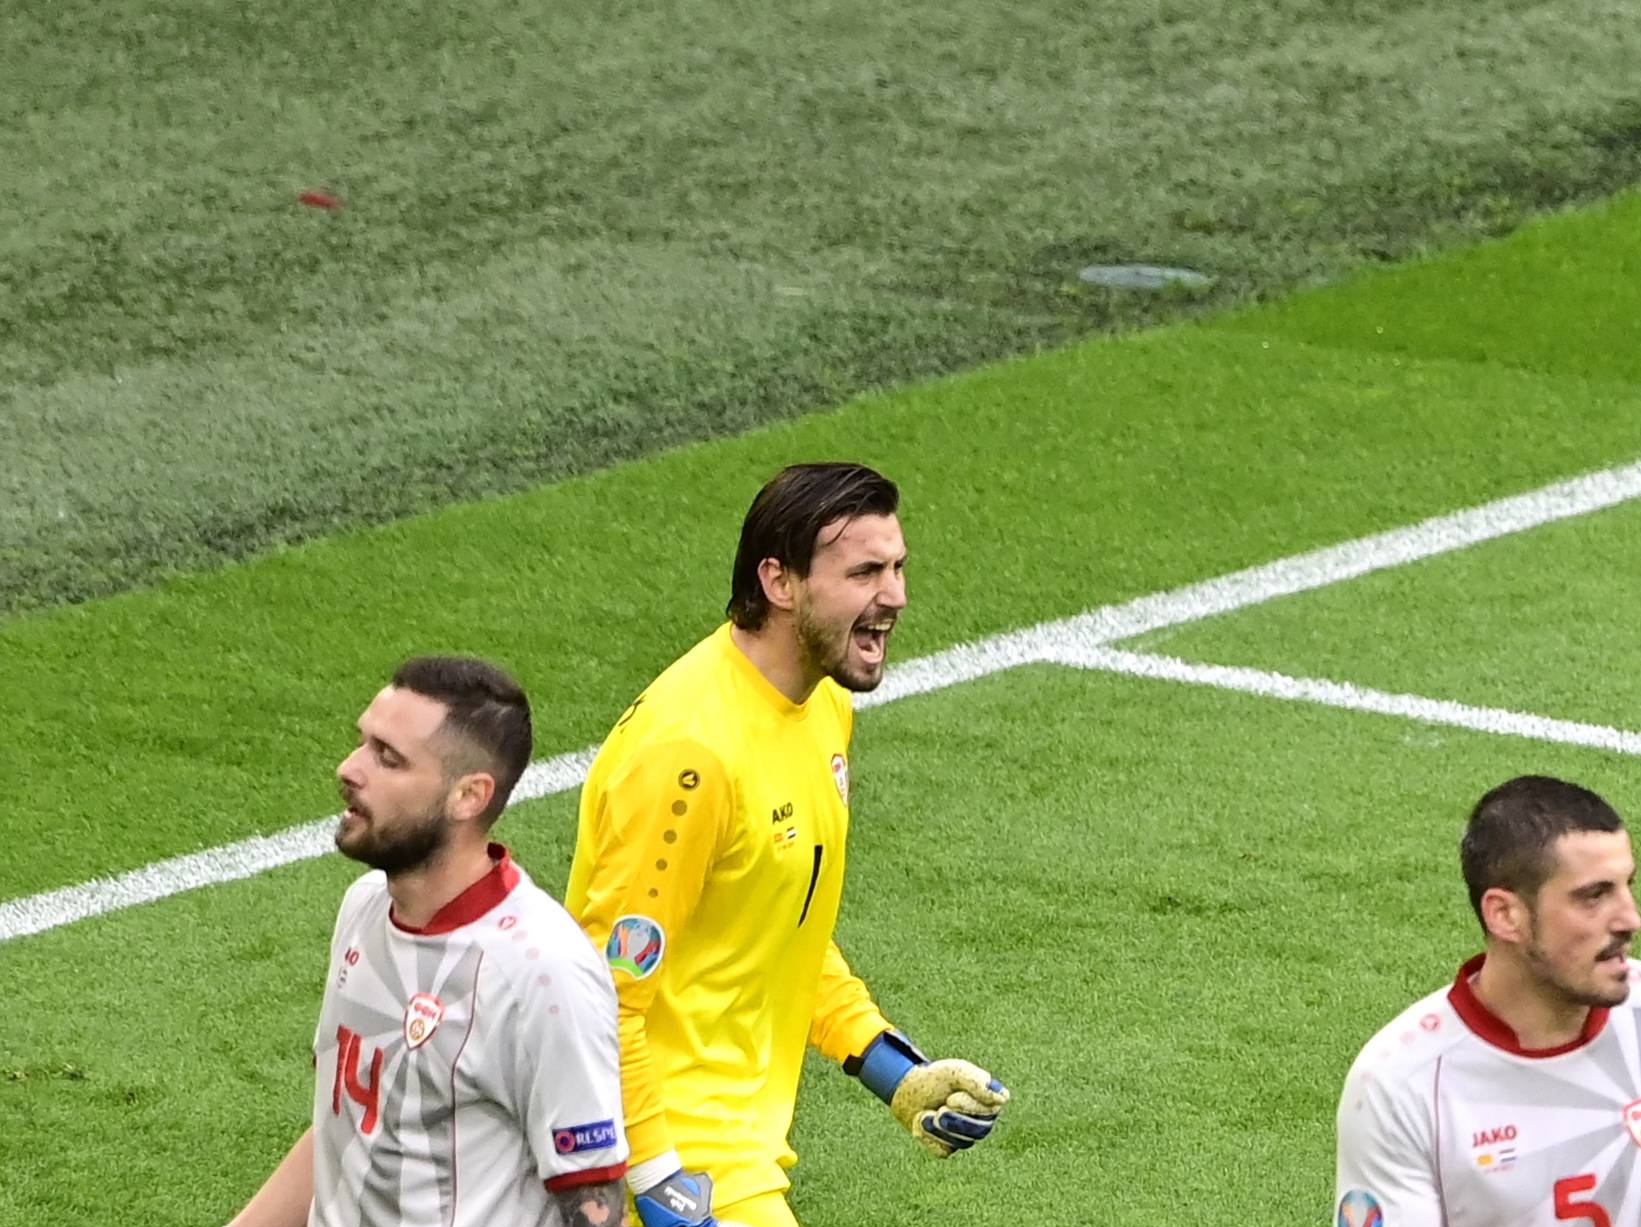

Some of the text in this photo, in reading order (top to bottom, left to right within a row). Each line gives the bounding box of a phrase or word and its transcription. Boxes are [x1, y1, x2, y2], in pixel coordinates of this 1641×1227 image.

[772, 801, 794, 825] AKO
[797, 844, 823, 928] 1
[332, 1024, 384, 1136] 14
[1472, 1125, 1517, 1148] JAKO
